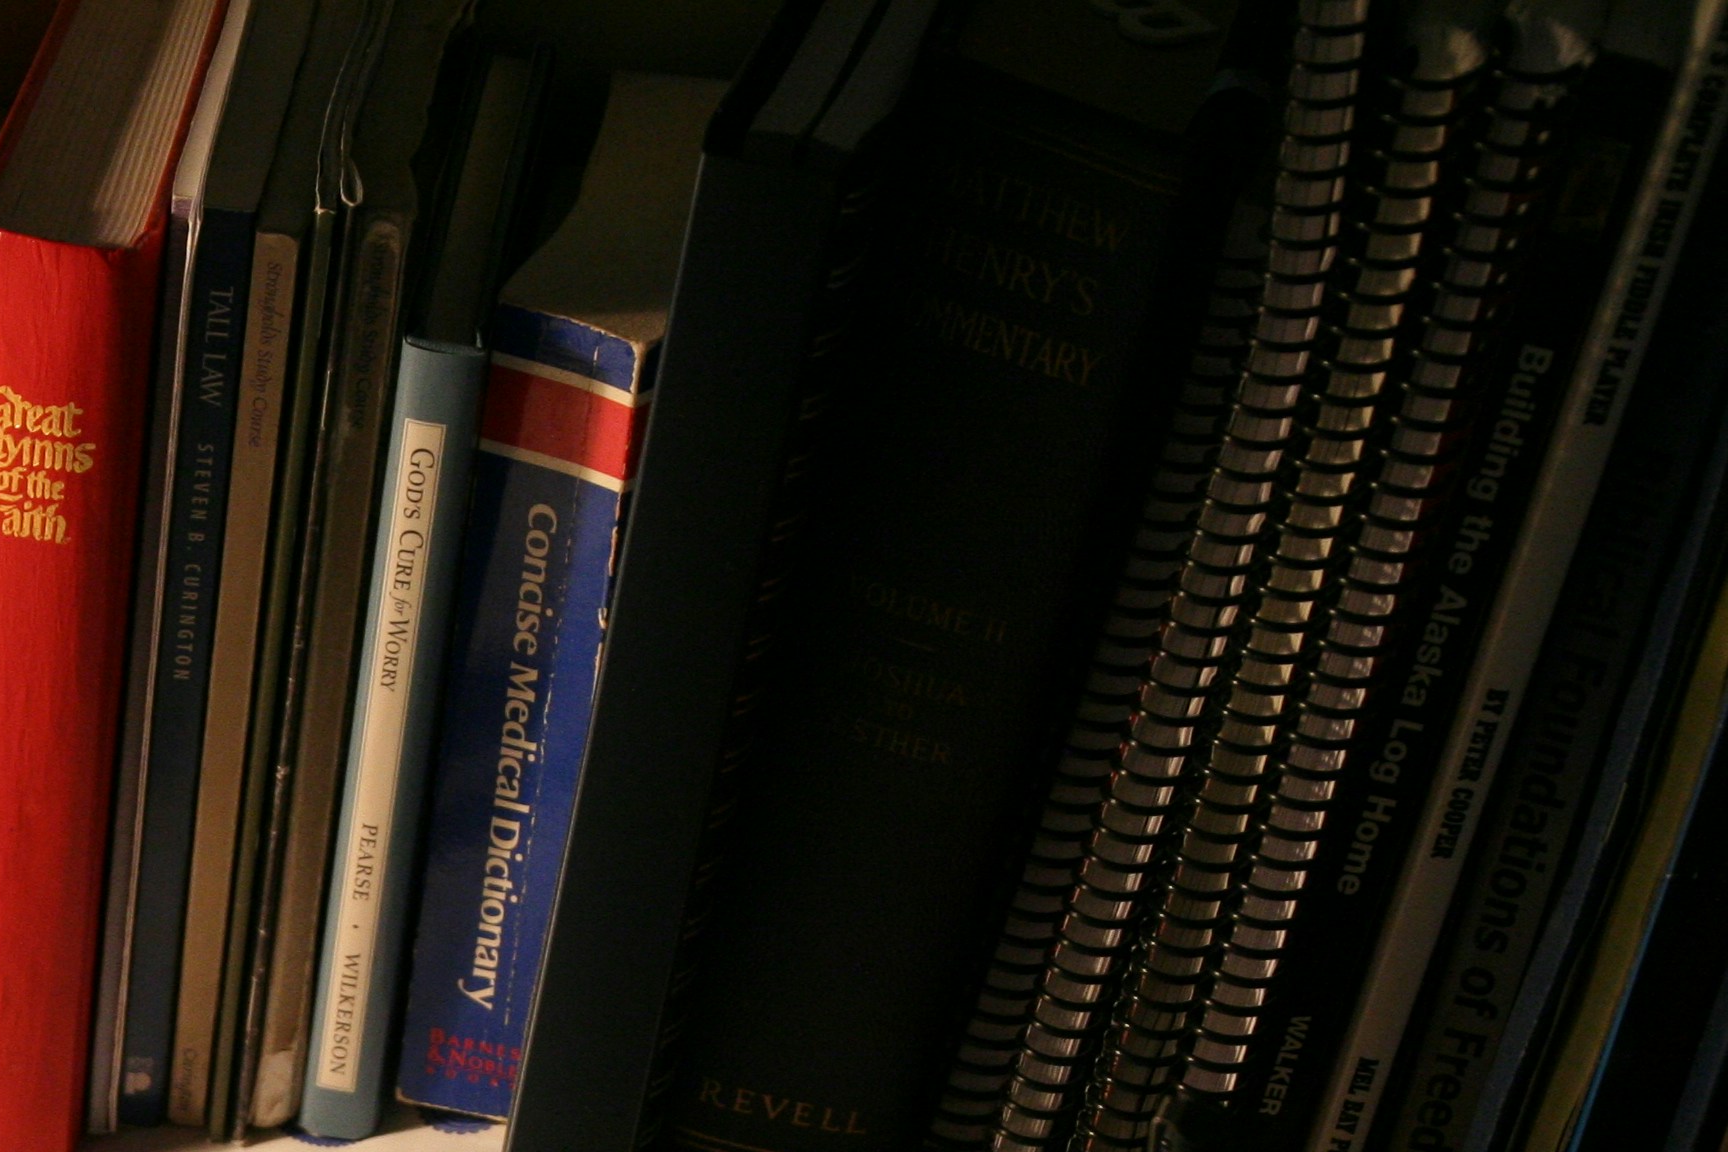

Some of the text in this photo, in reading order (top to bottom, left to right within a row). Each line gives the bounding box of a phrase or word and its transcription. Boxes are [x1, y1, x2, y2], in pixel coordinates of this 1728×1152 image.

[199, 286, 234, 407] TALL LAW
[26, 470, 64, 499] the
[173, 443, 214, 680] STEVEN B. CURINGTON
[380, 448, 435, 692] GOD'S CURE for WORRY
[1336, 344, 1556, 896] Building the Alaska Log Home
[457, 502, 558, 1013] Concise Medical Dictionary
[1431, 788, 1473, 859] COOPER
[329, 823, 378, 1075] PEARSE WILKERSON
[701, 1076, 866, 1135] REVELL
[1258, 1015, 1313, 1117] WALKER
[1336, 1101, 1366, 1135] BAY
